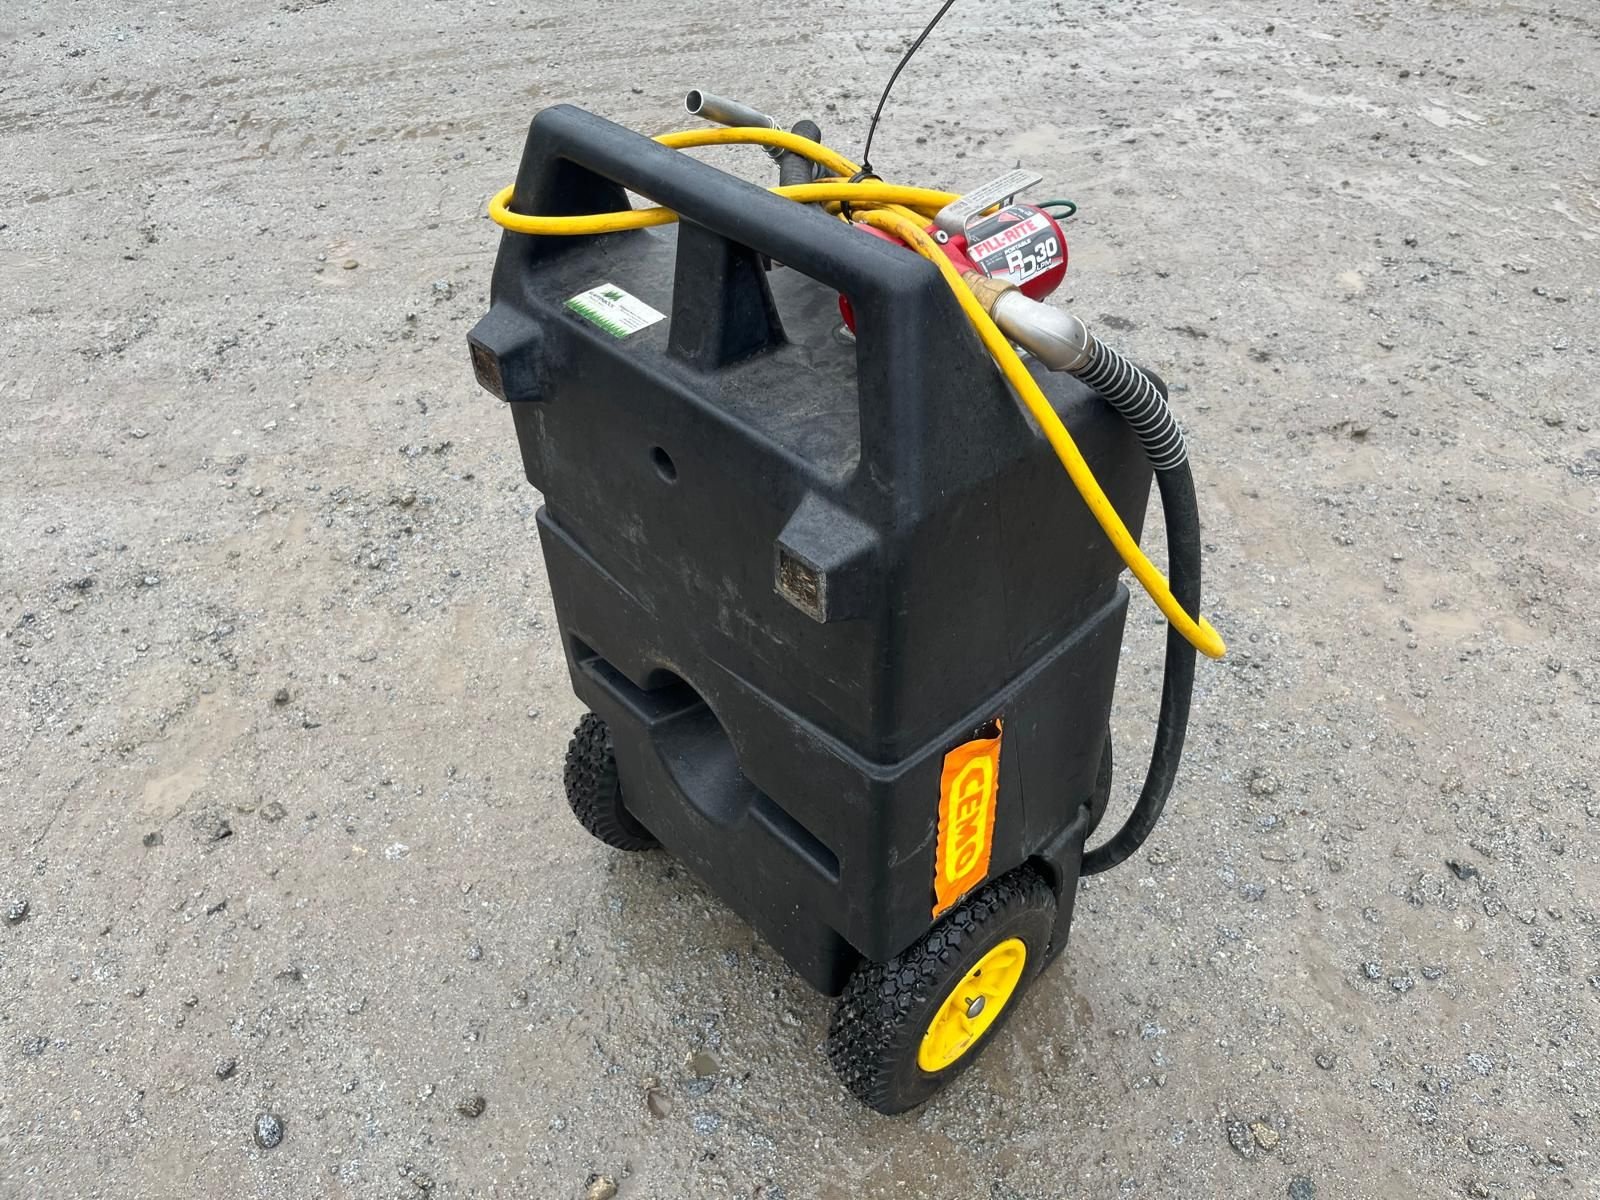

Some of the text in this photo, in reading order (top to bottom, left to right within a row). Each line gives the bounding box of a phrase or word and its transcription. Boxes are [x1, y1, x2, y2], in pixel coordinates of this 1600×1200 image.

[975, 219, 1038, 257] FILL-RITE
[1004, 238, 1032, 254] PORTABLE
[1036, 258, 1052, 271] LPM
[954, 766, 986, 872] CEMO
